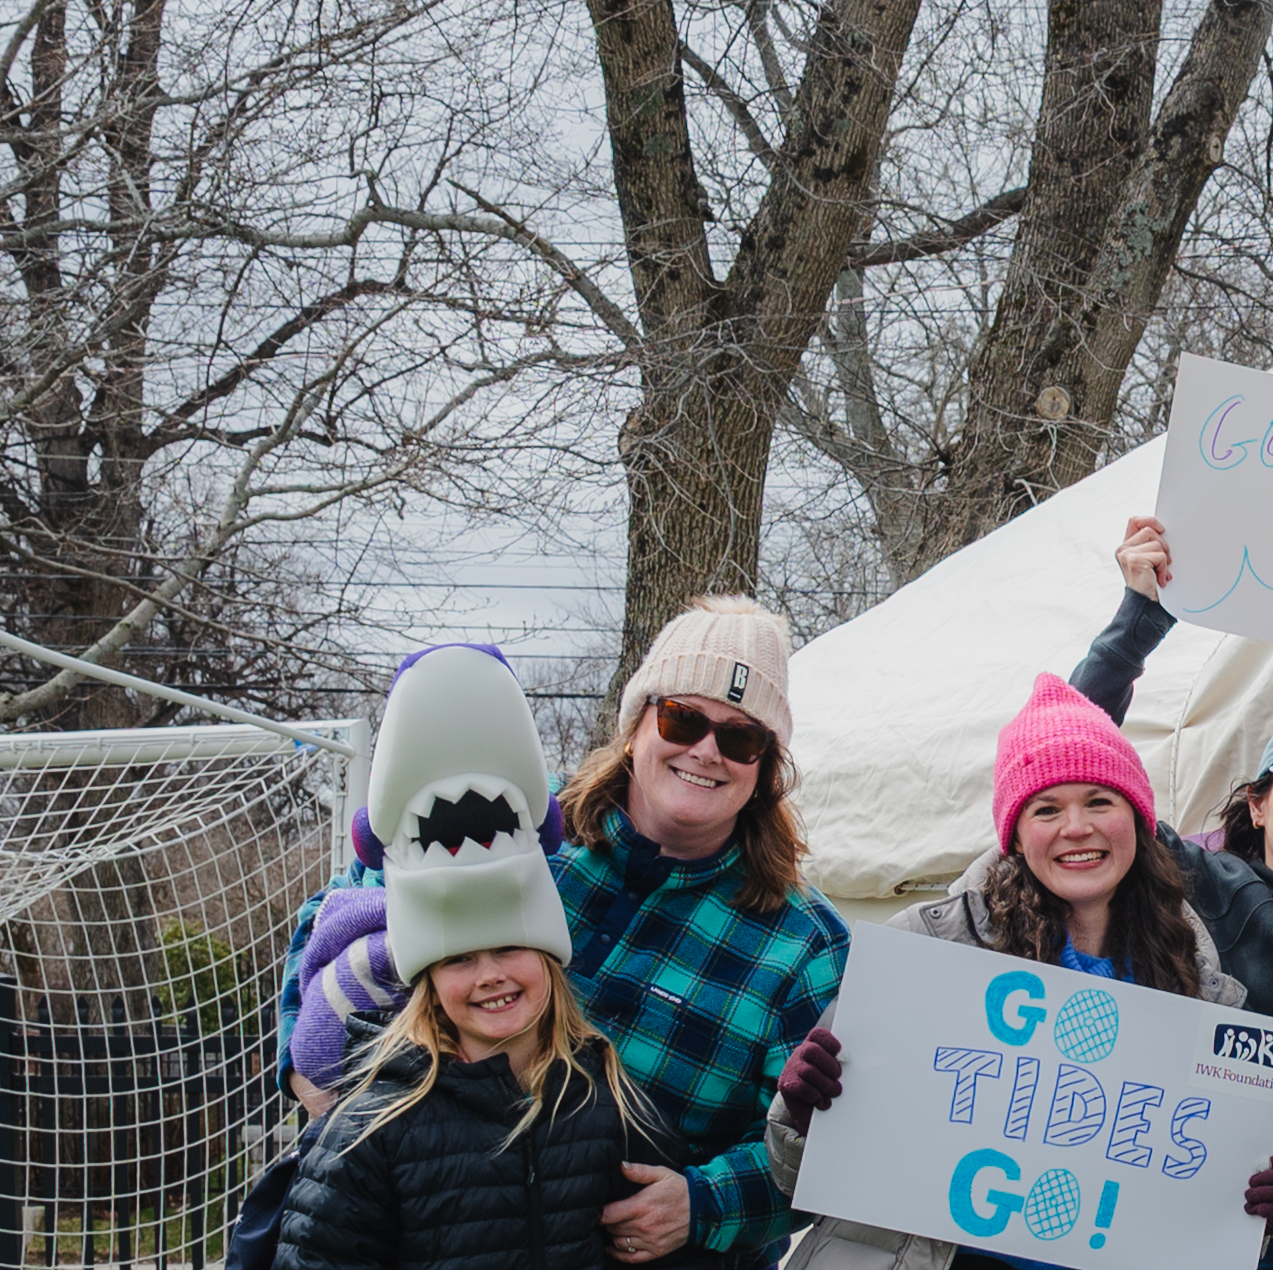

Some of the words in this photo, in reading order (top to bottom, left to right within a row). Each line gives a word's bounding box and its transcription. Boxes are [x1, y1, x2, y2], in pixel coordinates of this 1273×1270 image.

[984, 970, 1119, 1064] GO
[933, 1046, 1211, 1180] TIDES
[1195, 1063, 1222, 1078] IWK
[948, 1147, 1120, 1250] GO!
